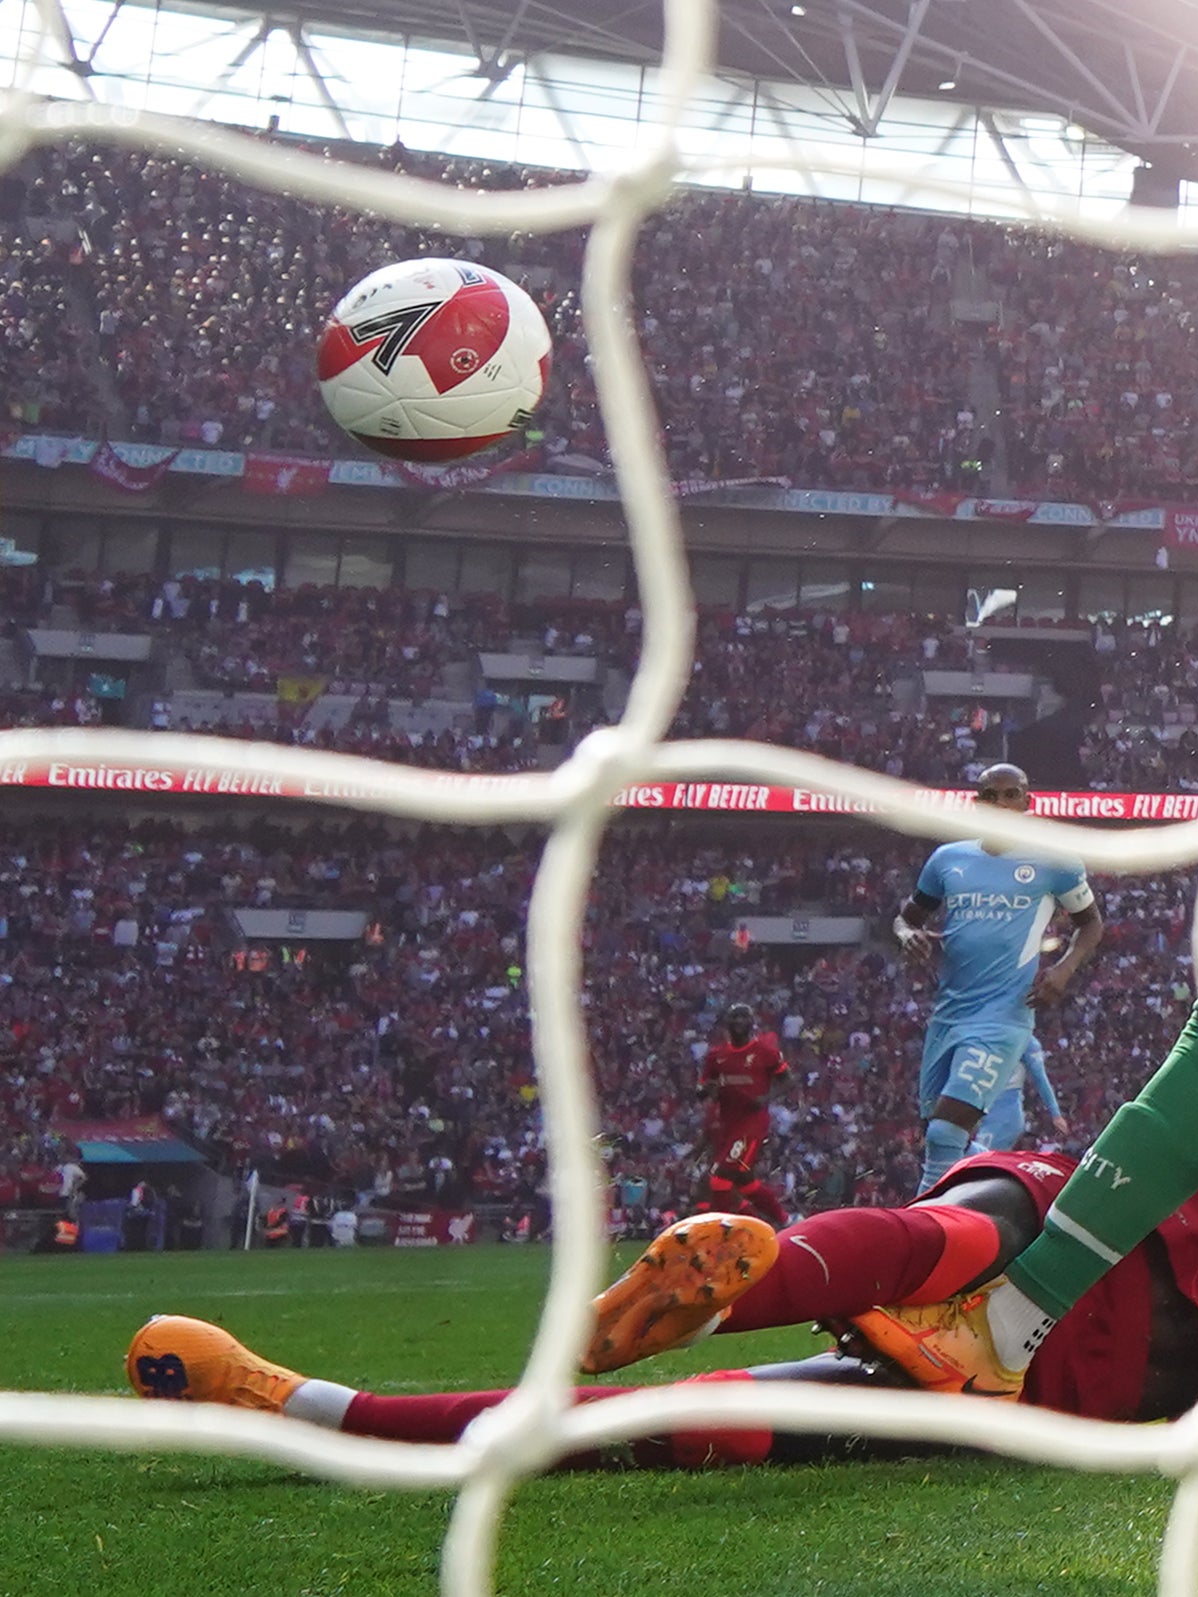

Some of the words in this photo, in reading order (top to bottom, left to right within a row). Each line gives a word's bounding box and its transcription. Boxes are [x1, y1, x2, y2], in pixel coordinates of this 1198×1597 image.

[48, 762, 174, 790] Emirates
[182, 767, 219, 791] FLY
[217, 769, 283, 794] BETTER
[706, 784, 770, 809] BETTER
[1131, 795, 1160, 818] FLY
[946, 892, 1032, 911] ETIHAD
[952, 909, 1014, 923] AIRWAYS
[958, 1047, 1005, 1090] 25
